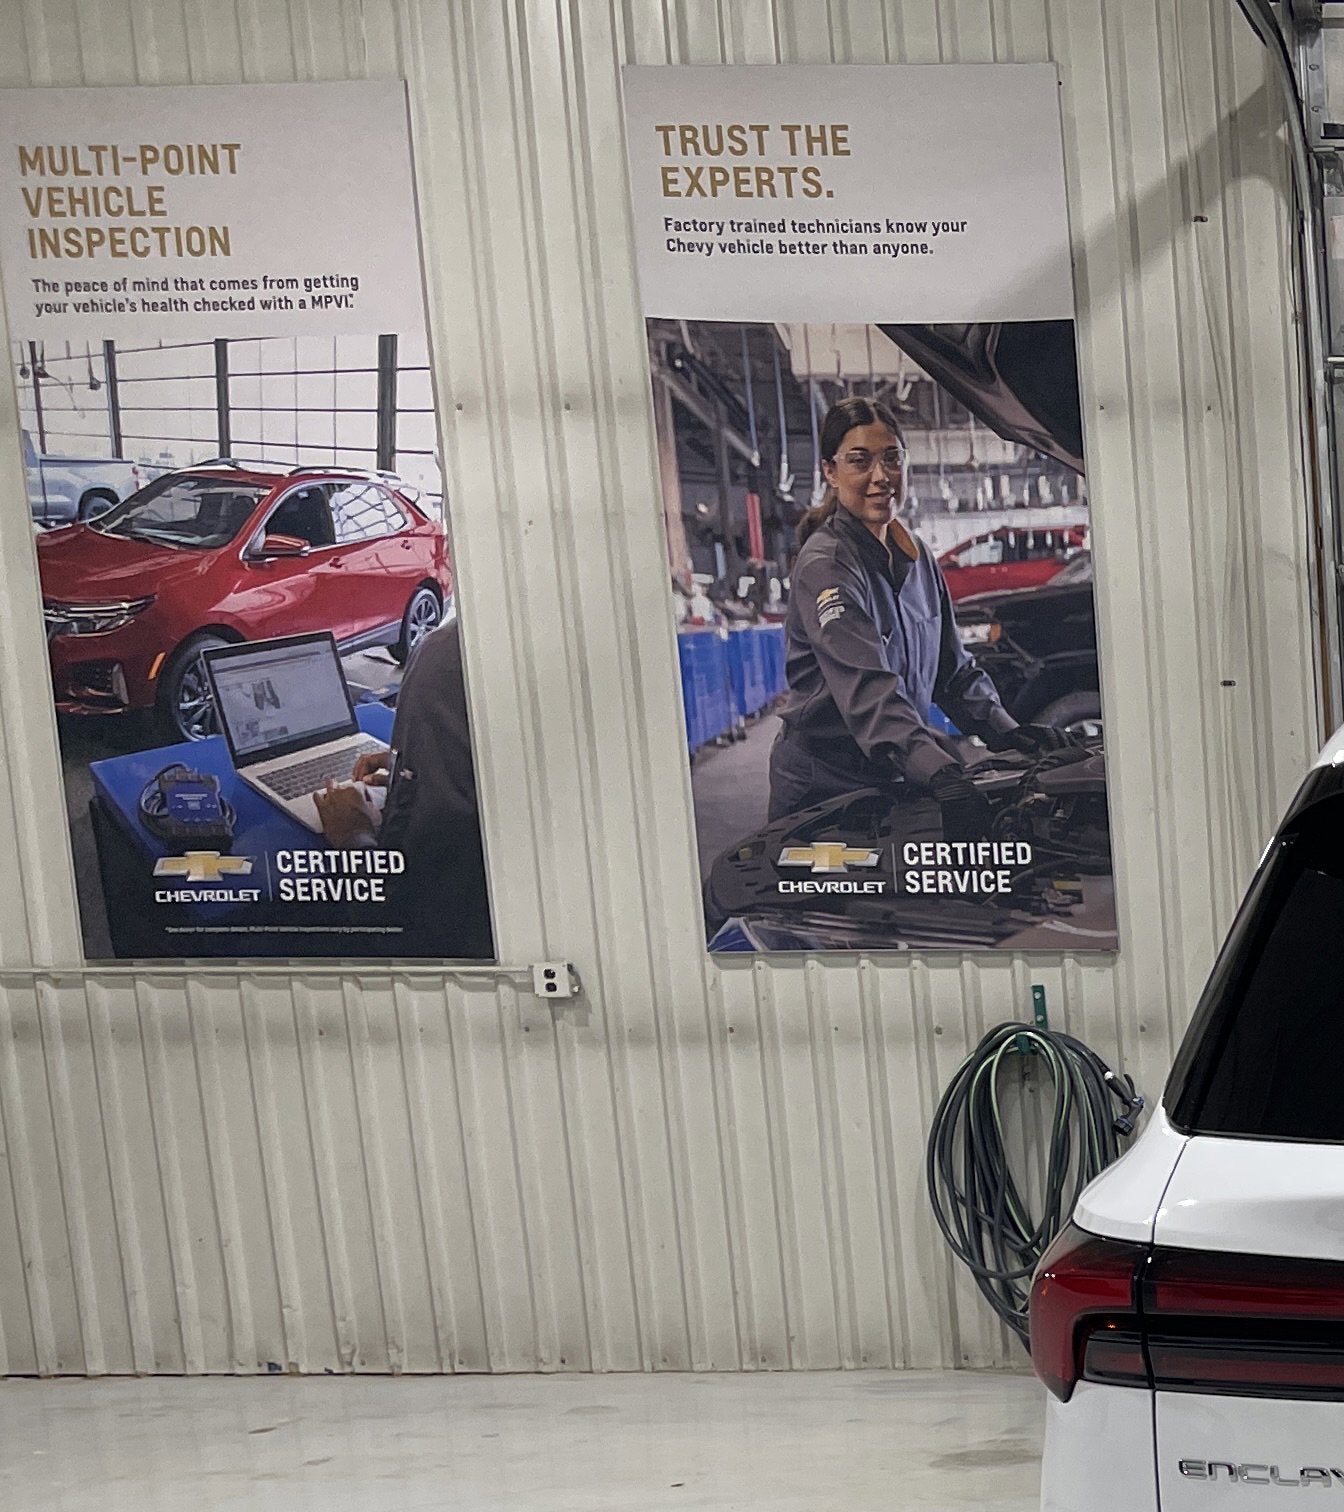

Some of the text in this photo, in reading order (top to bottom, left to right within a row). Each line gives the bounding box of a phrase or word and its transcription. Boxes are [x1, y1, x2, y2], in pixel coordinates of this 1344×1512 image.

[655, 124, 851, 157] TRUST THE
[18, 143, 241, 177] MULTI-POINT
[660, 166, 834, 199] EXPERTS.
[22, 185, 167, 219] VEHICLE
[664, 217, 967, 236] Factory trained technicians know your
[28, 226, 231, 260] INSPECTION
[666, 237, 934, 258] Chevy vehicle better than anyone.
[32, 274, 359, 297] The peace of mind that comes from getting
[35, 300, 69, 317] your
[73, 297, 137, 314] vehicle's
[141, 297, 189, 313] health
[193, 296, 255, 312] checked
[260, 295, 294, 311] with
[298, 298, 307, 310] a
[276, 849, 405, 875] CERTIFIED
[903, 842, 1032, 866] CERTIFIED
[279, 878, 386, 902] SERVICE
[777, 880, 886, 894] CHEVROLET
[904, 870, 1012, 894] SERVICE
[154, 888, 262, 904] CHEVROLET
